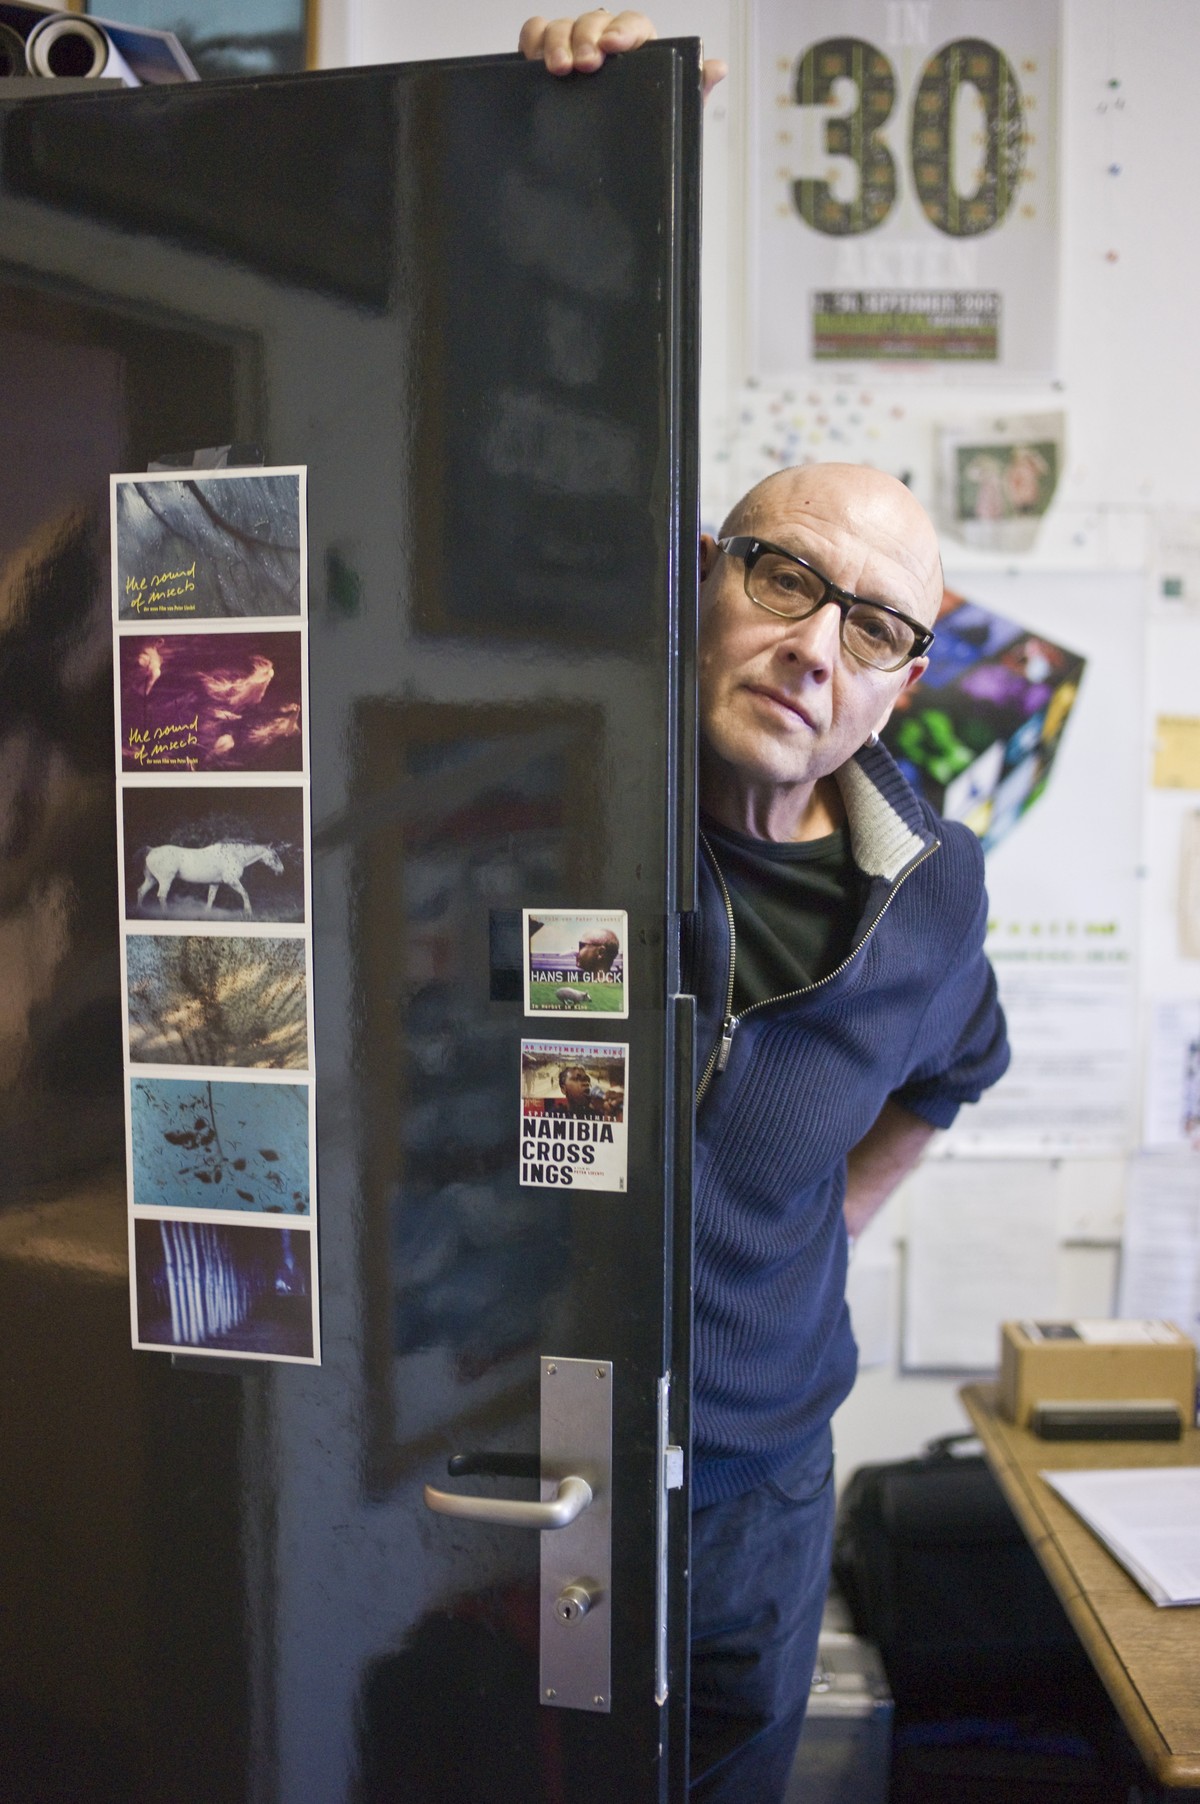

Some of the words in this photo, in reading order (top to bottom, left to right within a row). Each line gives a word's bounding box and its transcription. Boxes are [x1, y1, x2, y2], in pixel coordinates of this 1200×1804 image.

[790, 36, 1028, 238] 30
[126, 576, 148, 594] the
[151, 562, 196, 586] sound
[130, 592, 145, 613] of
[148, 579, 195, 605] insects
[129, 728, 151, 747] the
[154, 715, 198, 739] sound
[134, 744, 148, 766] of
[151, 733, 198, 757] insects
[531, 971, 564, 983] HANS
[567, 971, 579, 983] IM
[583, 969, 622, 983] GLÜCK
[539, 1045, 585, 1053] SEPTEMBER
[603, 1048, 623, 1056] KINO
[528, 1110, 566, 1119] SPIRITS
[584, 1114, 617, 1122] LIMITS
[523, 1118, 614, 1143] NAMIBIA
[522, 1140, 595, 1164] CROSS
[522, 1163, 574, 1185] INGS
